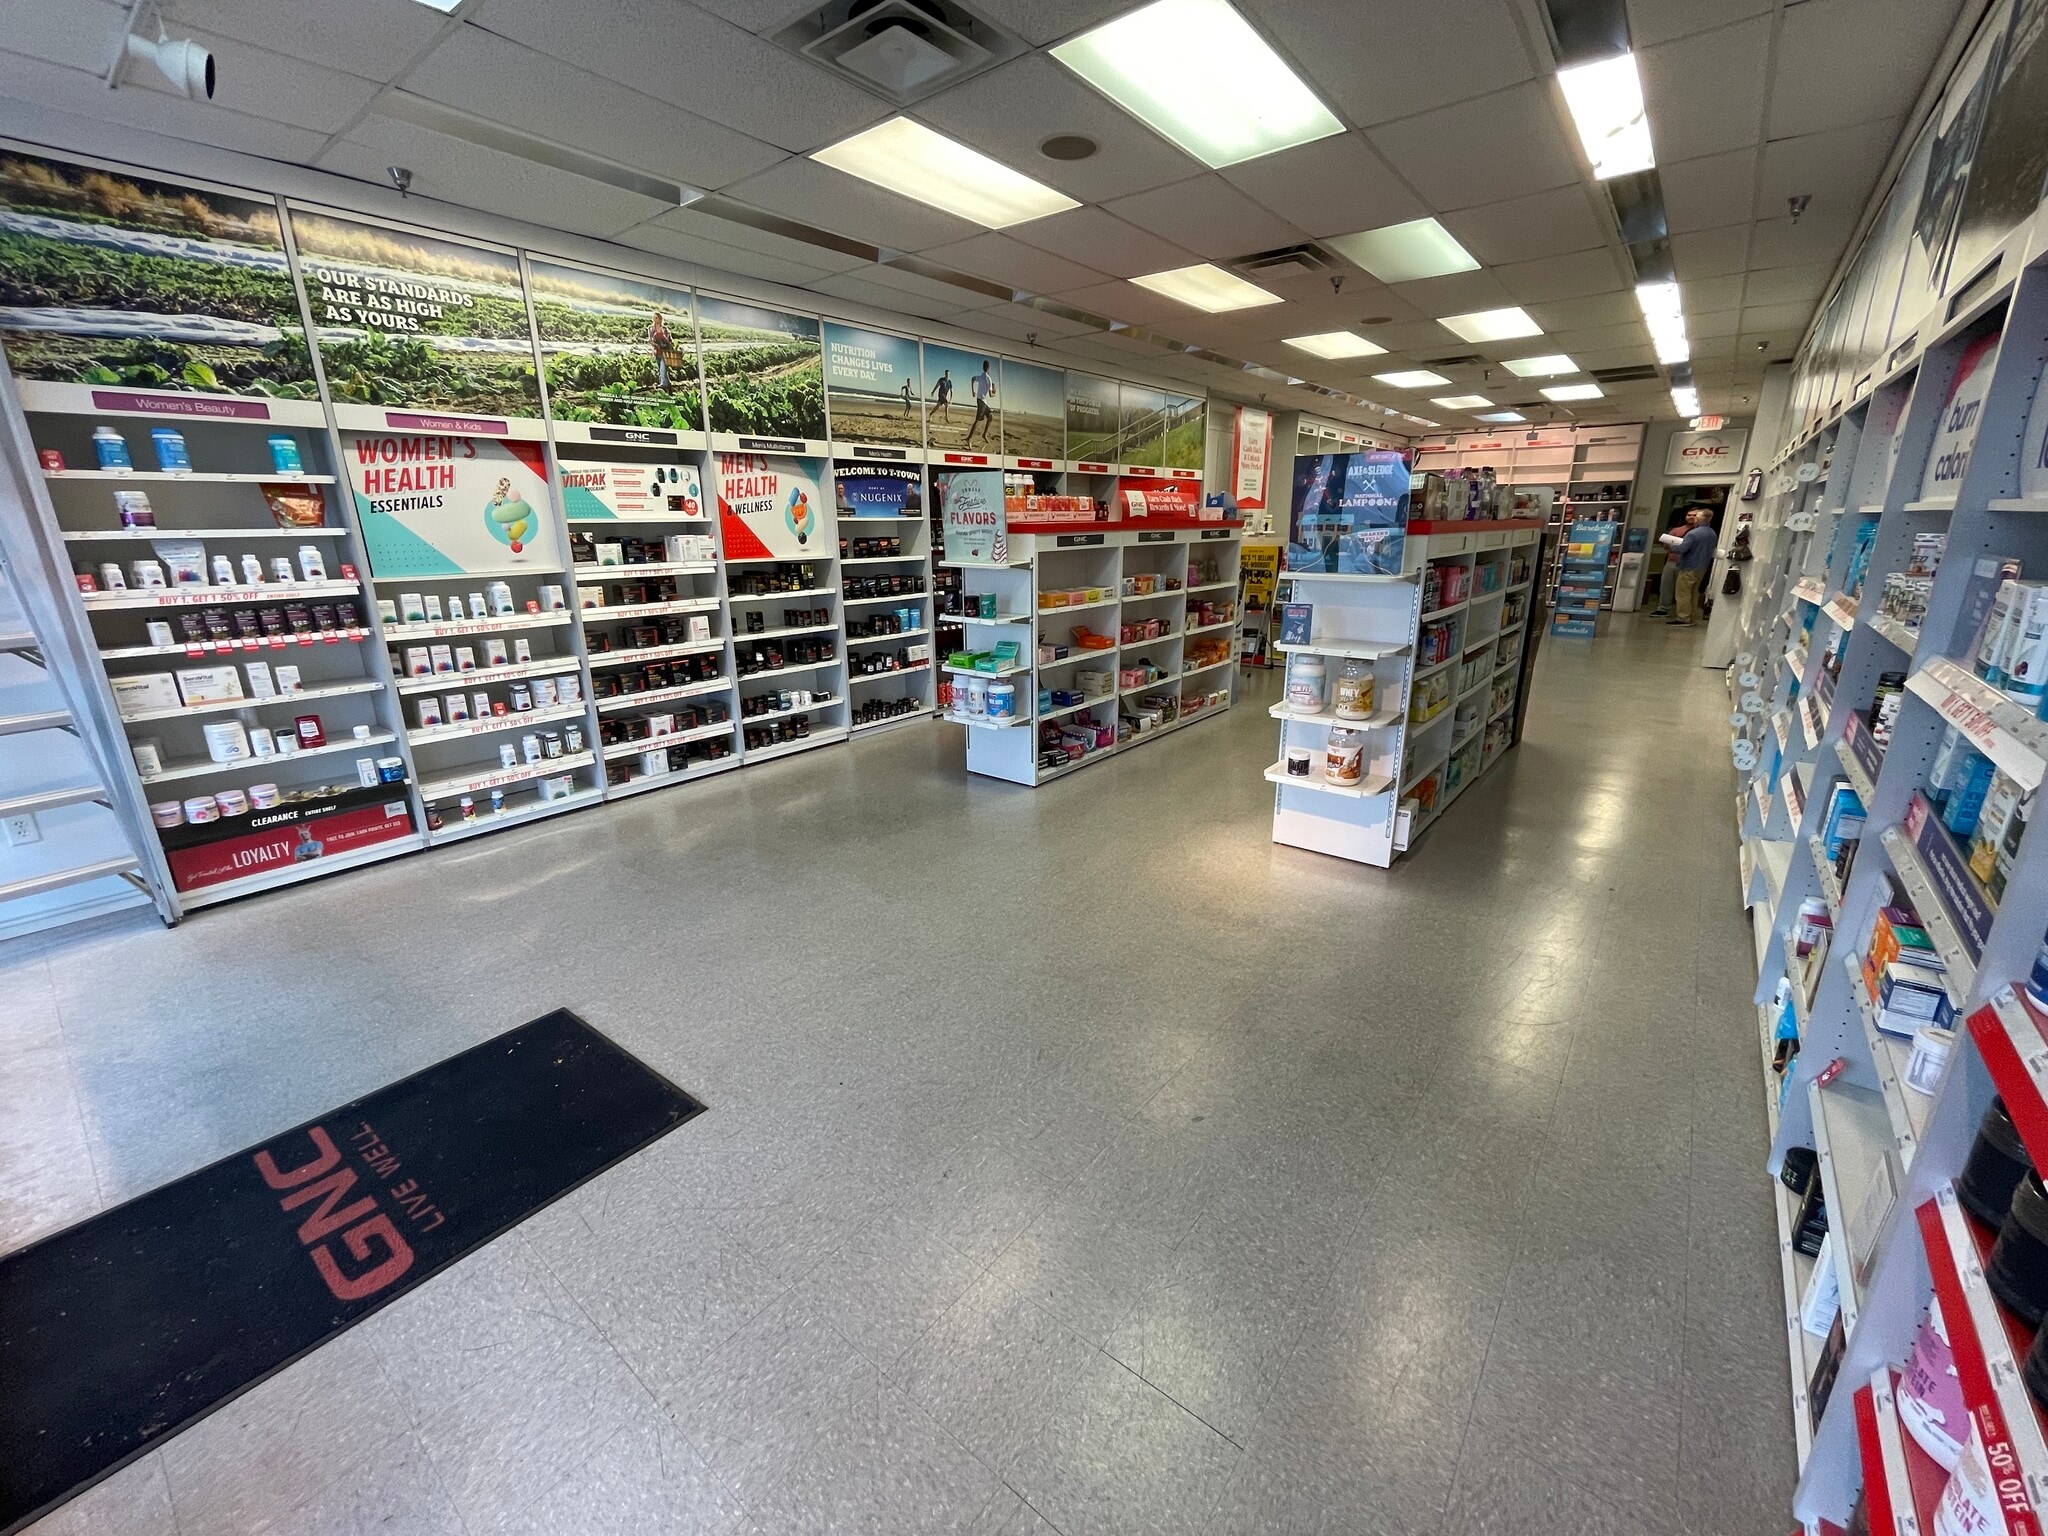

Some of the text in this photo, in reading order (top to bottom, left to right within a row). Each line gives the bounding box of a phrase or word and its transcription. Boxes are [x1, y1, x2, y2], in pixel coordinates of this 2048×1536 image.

[317, 269, 474, 307] OUR STANDARDS
[322, 287, 443, 318] ARE AS HIGH
[326, 305, 424, 331] AS YOURS.
[830, 342, 876, 359] NUTRITION
[832, 354, 893, 373] CHANGES LIVES
[832, 366, 877, 381] EVERY DAY.
[136, 399, 236, 416] Women's Beauty
[1947, 398, 1981, 433] burn
[420, 419, 453, 428] Women
[464, 422, 482, 431] Kids
[1701, 417, 1719, 428] EXIT
[626, 432, 650, 440] GNC
[356, 437, 476, 464] WOMEN'S
[1682, 446, 1730, 456] GNC
[722, 454, 768, 475] MEN'S
[364, 465, 454, 494] HEALTH
[562, 474, 606, 488] VITAPAK
[889, 468, 920, 481] T-TOWN
[725, 475, 778, 500] HEALTH
[370, 496, 443, 513] ESSENTIALS
[860, 494, 902, 502] NUGENIX
[726, 500, 772, 516] & WELLNESS
[951, 512, 996, 525] FLAVORS
[160, 596, 178, 604] BUY
[192, 594, 208, 603] GET
[1340, 688, 1360, 696] WHEY
[489, 780, 500, 788] GET
[506, 774, 520, 783] 50%
[521, 771, 531, 780] OFF
[252, 811, 298, 827] CLEARANCE
[232, 841, 290, 868] LOYALTY
[350, 1122, 446, 1233] LIVE WELL
[254, 1125, 414, 1300] GNC
[1988, 1442, 2016, 1476] 50%
[1999, 1478, 2031, 1512] OFF
